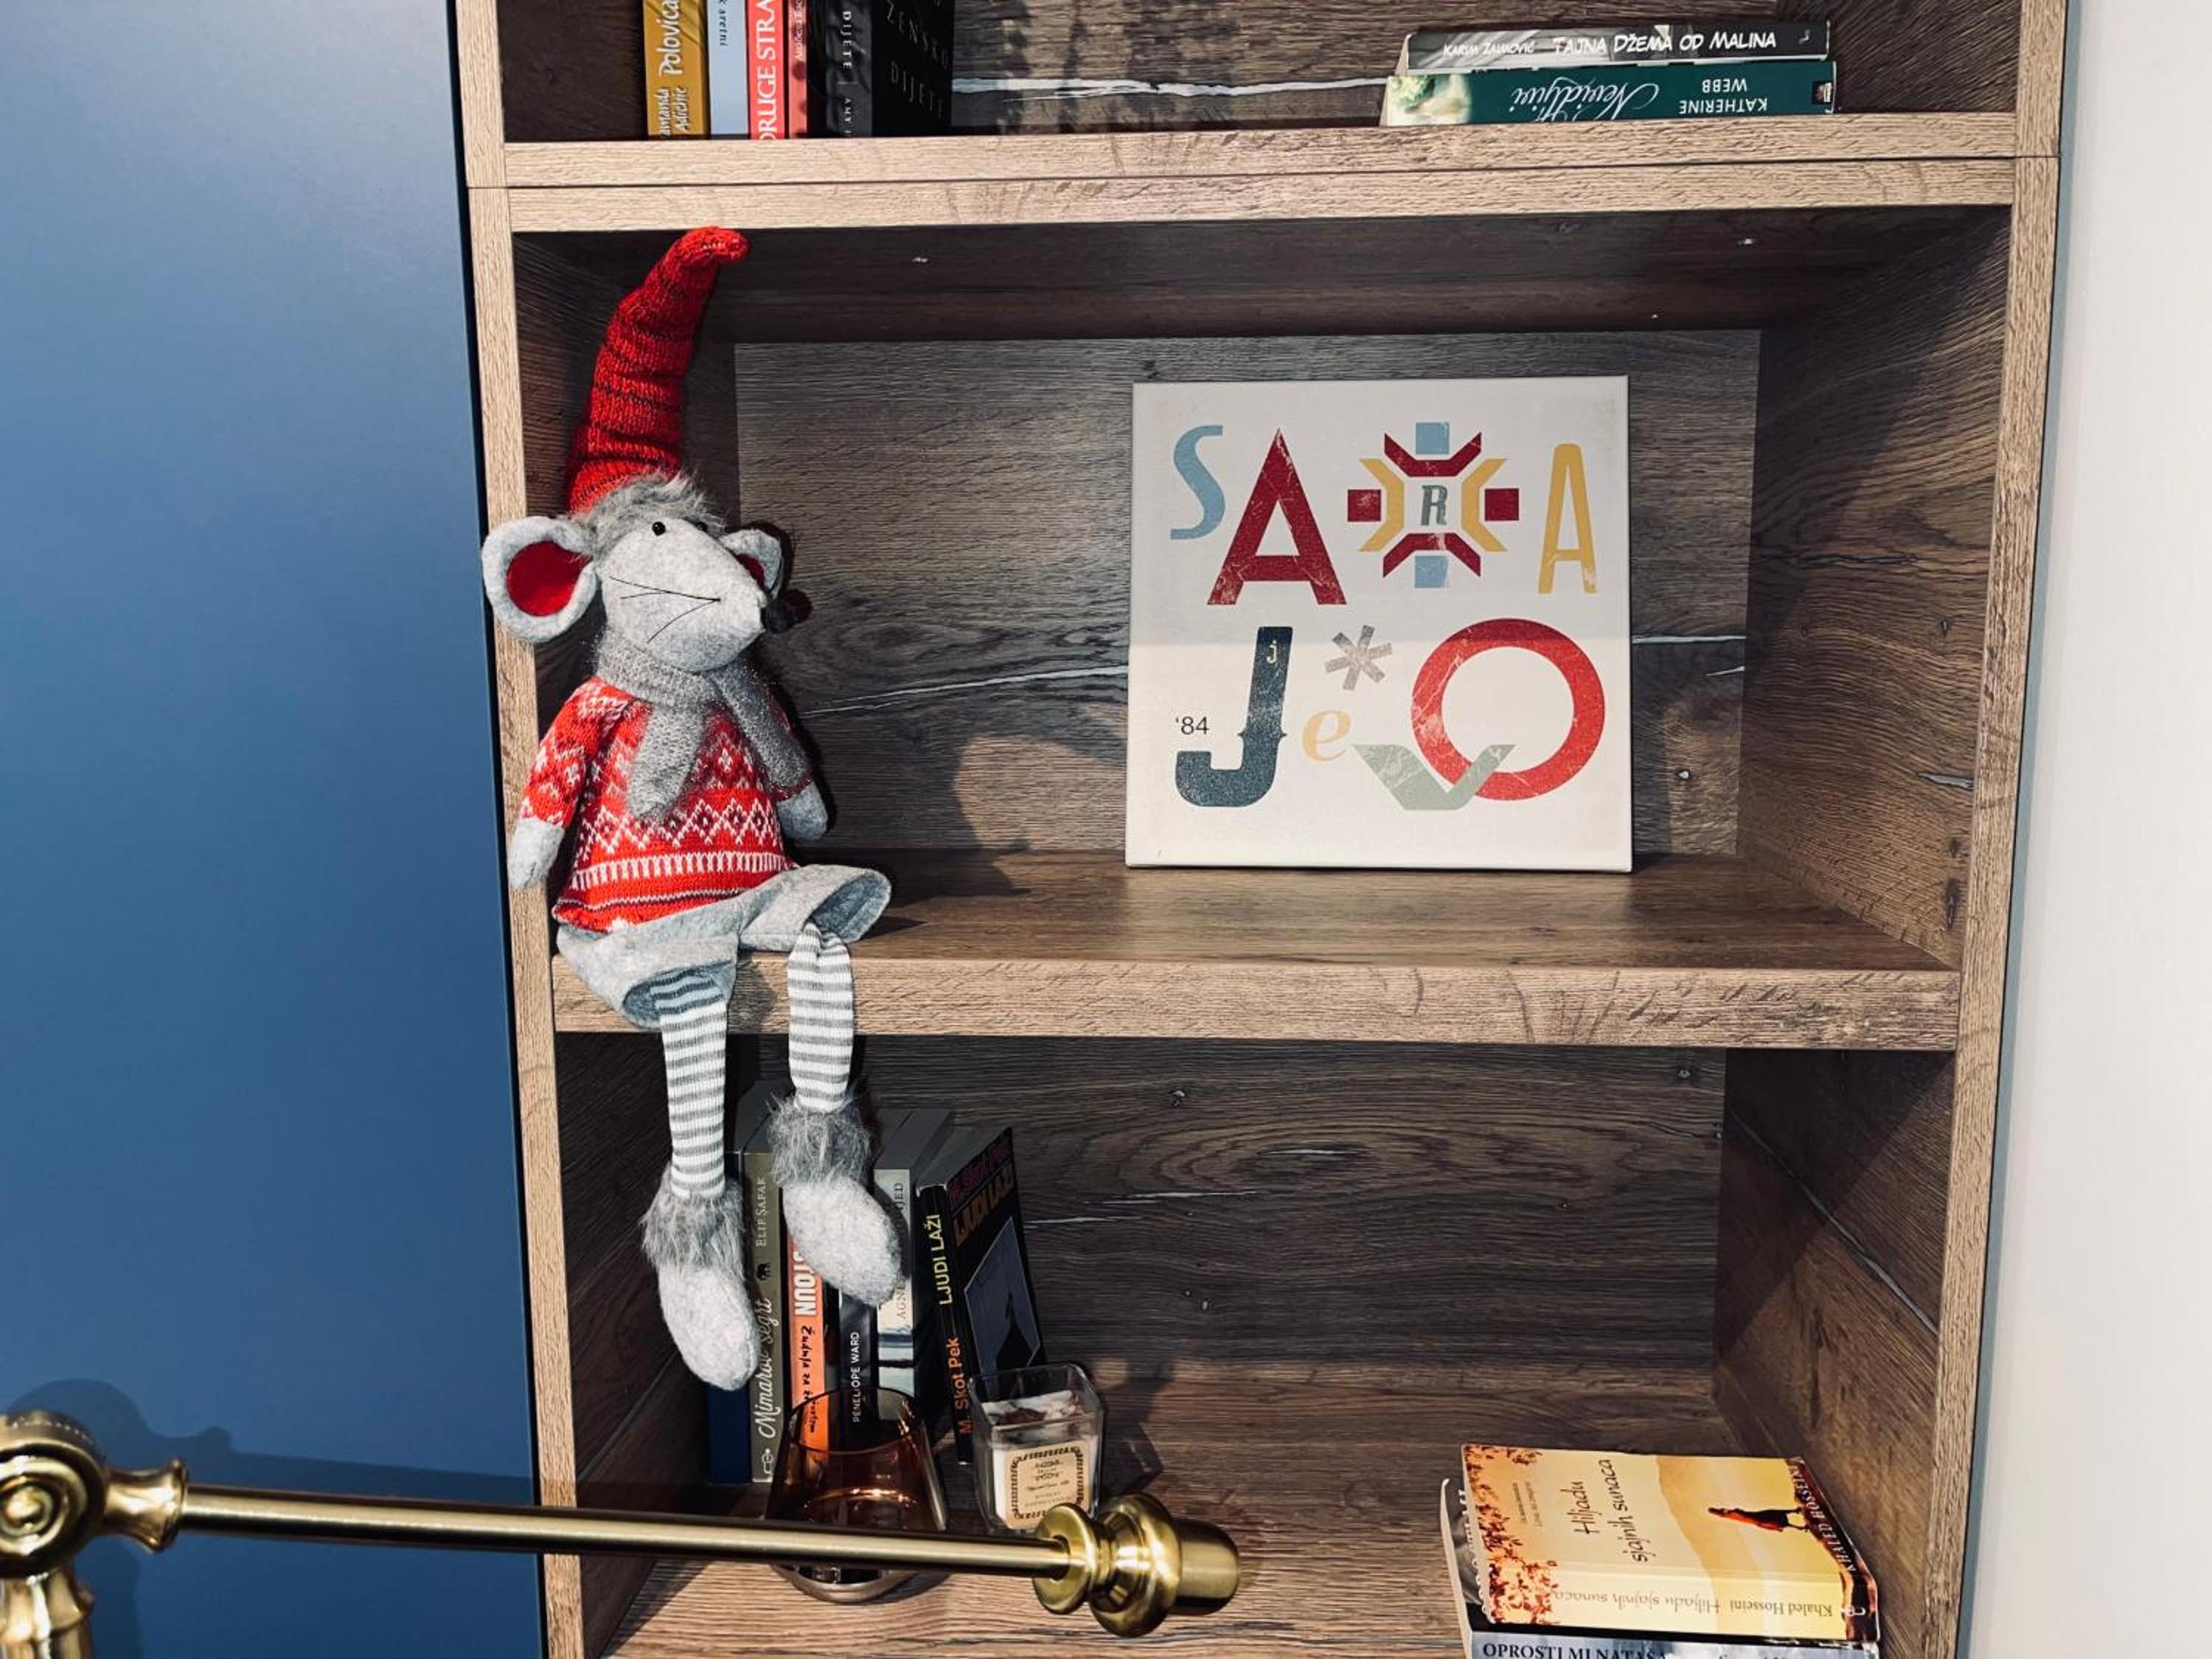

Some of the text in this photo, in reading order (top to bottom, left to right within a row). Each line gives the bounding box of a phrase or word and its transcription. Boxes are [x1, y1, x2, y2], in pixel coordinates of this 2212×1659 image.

[839, 10, 852, 71] DIJETE
[1443, 44, 1479, 57] KARIM
[1552, 31, 1777, 55] TAJNA DŽEMA OD MALINA
[1701, 77, 1747, 94] WEBB
[1679, 97, 1769, 114] KATHERINE
[924, 1214, 953, 1305] LJUDI LAŽI
[946, 1337, 963, 1368] Pek
[850, 1331, 862, 1424] PENELOPE WARD
[951, 1373, 970, 1410] Skot
[1559, 1480, 1601, 1535] Hiljadu
[1598, 1458, 1657, 1563] sjajnih sunaca
[1788, 1465, 1857, 1573] KHALED HOSSEINI
[1552, 1590, 1608, 1602] sunaca
[1665, 1593, 1722, 1614] Hiljadu
[1730, 1599, 1784, 1615] Hosseini
[1788, 1602, 1833, 1617] Khaled
[1483, 1642, 1563, 1659] OPROSTI
[1568, 1647, 1592, 1659] MI
